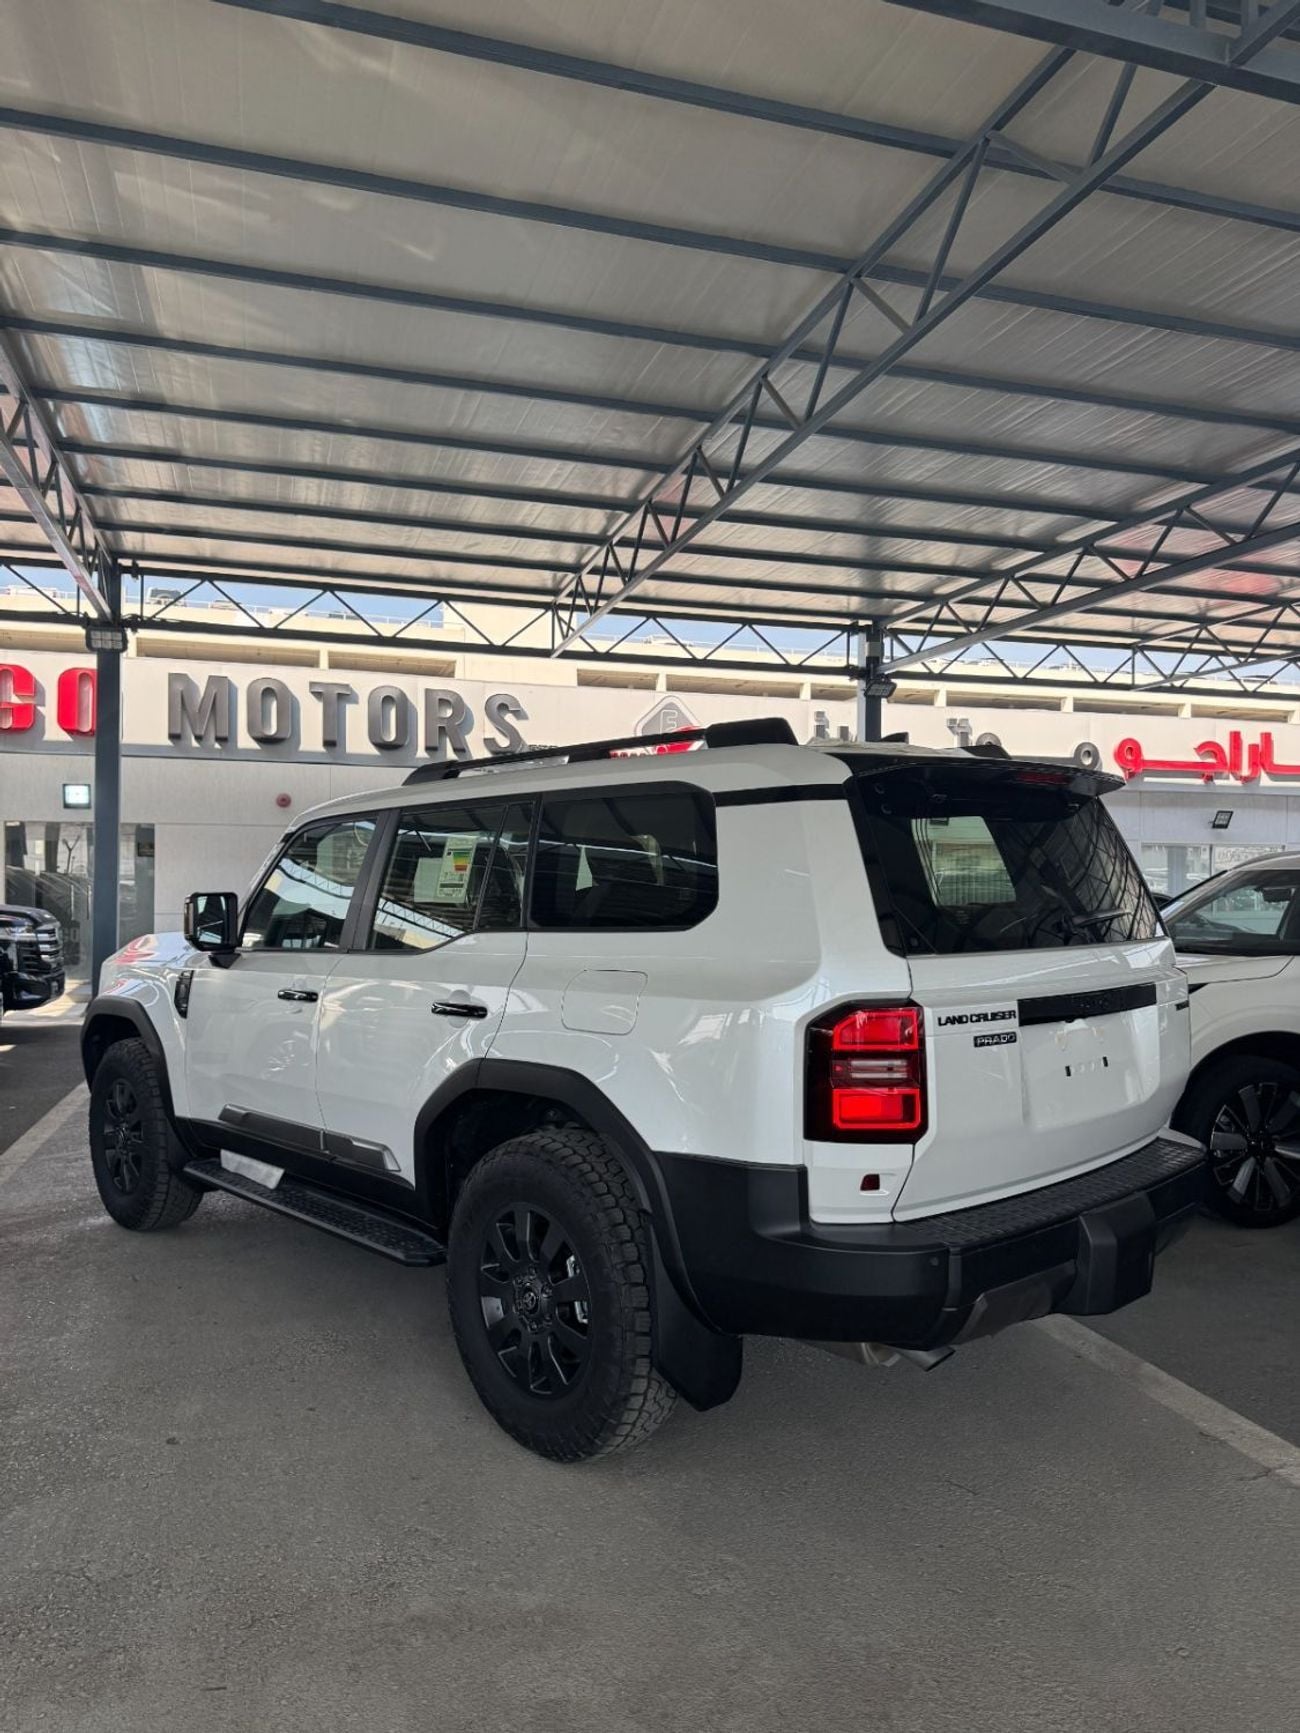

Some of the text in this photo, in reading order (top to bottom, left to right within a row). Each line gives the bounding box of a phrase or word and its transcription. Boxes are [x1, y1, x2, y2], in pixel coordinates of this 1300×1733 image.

[168, 672, 523, 755] MOTORS
[937, 1009, 1017, 1027] LAND CRUISER
[976, 1033, 1016, 1047] PRADO
